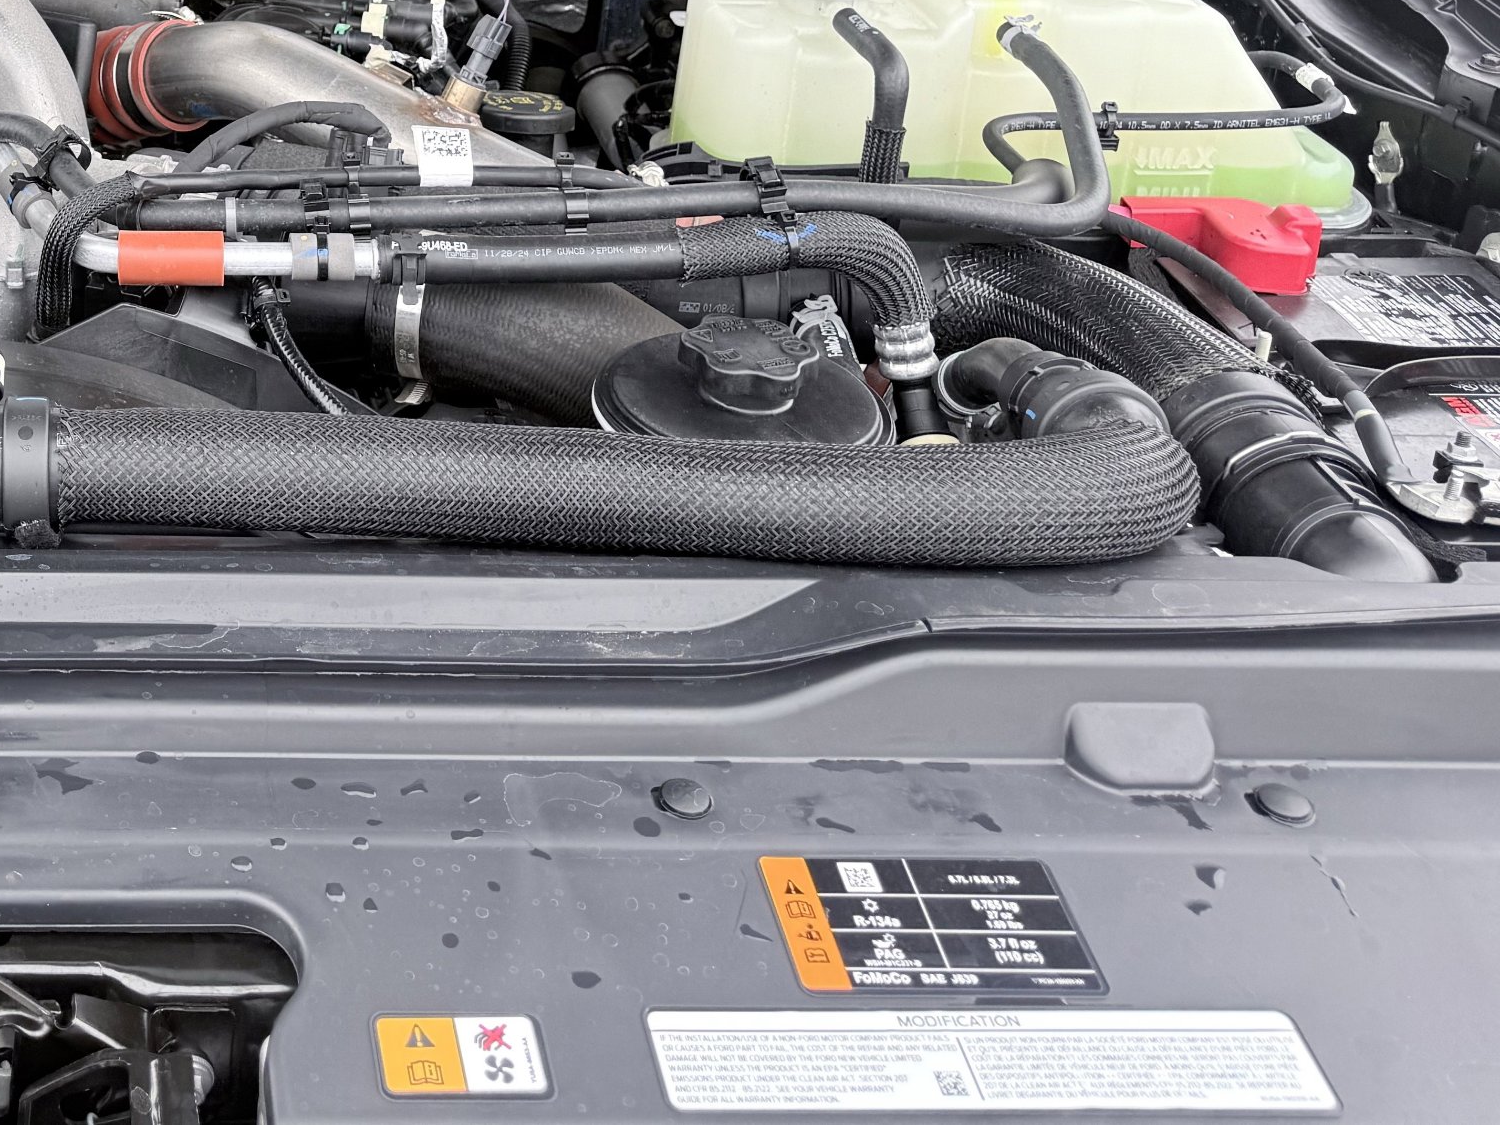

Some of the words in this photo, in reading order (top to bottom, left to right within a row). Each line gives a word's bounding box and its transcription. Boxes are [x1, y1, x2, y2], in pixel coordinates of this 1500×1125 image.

[1184, 121, 1209, 129] 7.5mm
[1148, 147, 1217, 169] MAX
[629, 245, 647, 254] MEX
[1002, 900, 1020, 913] kg
[853, 915, 901, 927] R-134a
[987, 938, 1008, 950] 3.7
[1010, 938, 1020, 949] fl
[1021, 940, 1038, 950] oz
[874, 948, 905, 960] PAG
[1024, 952, 1045, 964] cc)
[853, 972, 912, 984] FoMoCo
[920, 974, 947, 984] SAE
[896, 1015, 1021, 1027] MODIFICATION
[669, 1034, 683, 1042] THE
[760, 1034, 771, 1042] OF
[820, 1034, 849, 1042] MOTOR
[849, 1034, 889, 1042] COMPANY
[889, 1034, 926, 1042] PRODUCT
[674, 1044, 706, 1052] CAUSES
[713, 1044, 735, 1052] FORD
[736, 1044, 757, 1052] PART
[758, 1044, 769, 1052] TO
[790, 1044, 806, 1052] THE
[806, 1044, 827, 1052] COST
[828, 1044, 840, 1052] OF
[841, 1044, 856, 1052] THE
[856, 1044, 886, 1052] REPAIR
[886, 1044, 904, 1052] AND
[904, 1044, 922, 1052] ANY
[922, 1044, 958, 1052] RELATED
[720, 1054, 737, 1062] NOT
[737, 1054, 748, 1062] BE
[748, 1054, 786, 1062] COVERED
[786, 1054, 798, 1062] BY
[799, 1054, 814, 1062] THE
[815, 1054, 836, 1062] FORD
[837, 1054, 857, 1062] NEW
[857, 1054, 890, 1062] VEHICLE
[890, 1054, 923, 1062] LIMITED
[668, 1064, 714, 1073] WARRANTY
[714, 1064, 746, 1072] UNLESS
[747, 1064, 762, 1072] THE
[763, 1064, 801, 1072] PRODUCT
[801, 1064, 810, 1072] IS
[810, 1064, 823, 1072] AN
[671, 1074, 714, 1083] EMISSIONS
[714, 1074, 752, 1083] PRODUCT
[754, 1074, 781, 1083] UNDER
[782, 1074, 798, 1083] THE
[798, 1074, 825, 1083] CLEAN
[825, 1074, 840, 1083] AIR
[674, 1085, 692, 1093] AND
[692, 1085, 708, 1093] CFR
[776, 1085, 791, 1093] SEE
[791, 1085, 815, 1093] YOUR
[815, 1085, 848, 1093] VEHICLE
[849, 1085, 896, 1093] WARRANTY
[677, 1095, 702, 1103] GUIDE
[702, 1095, 719, 1103] FOR
[720, 1095, 734, 1103] ALL
[736, 1095, 782, 1103] WARRANTY
